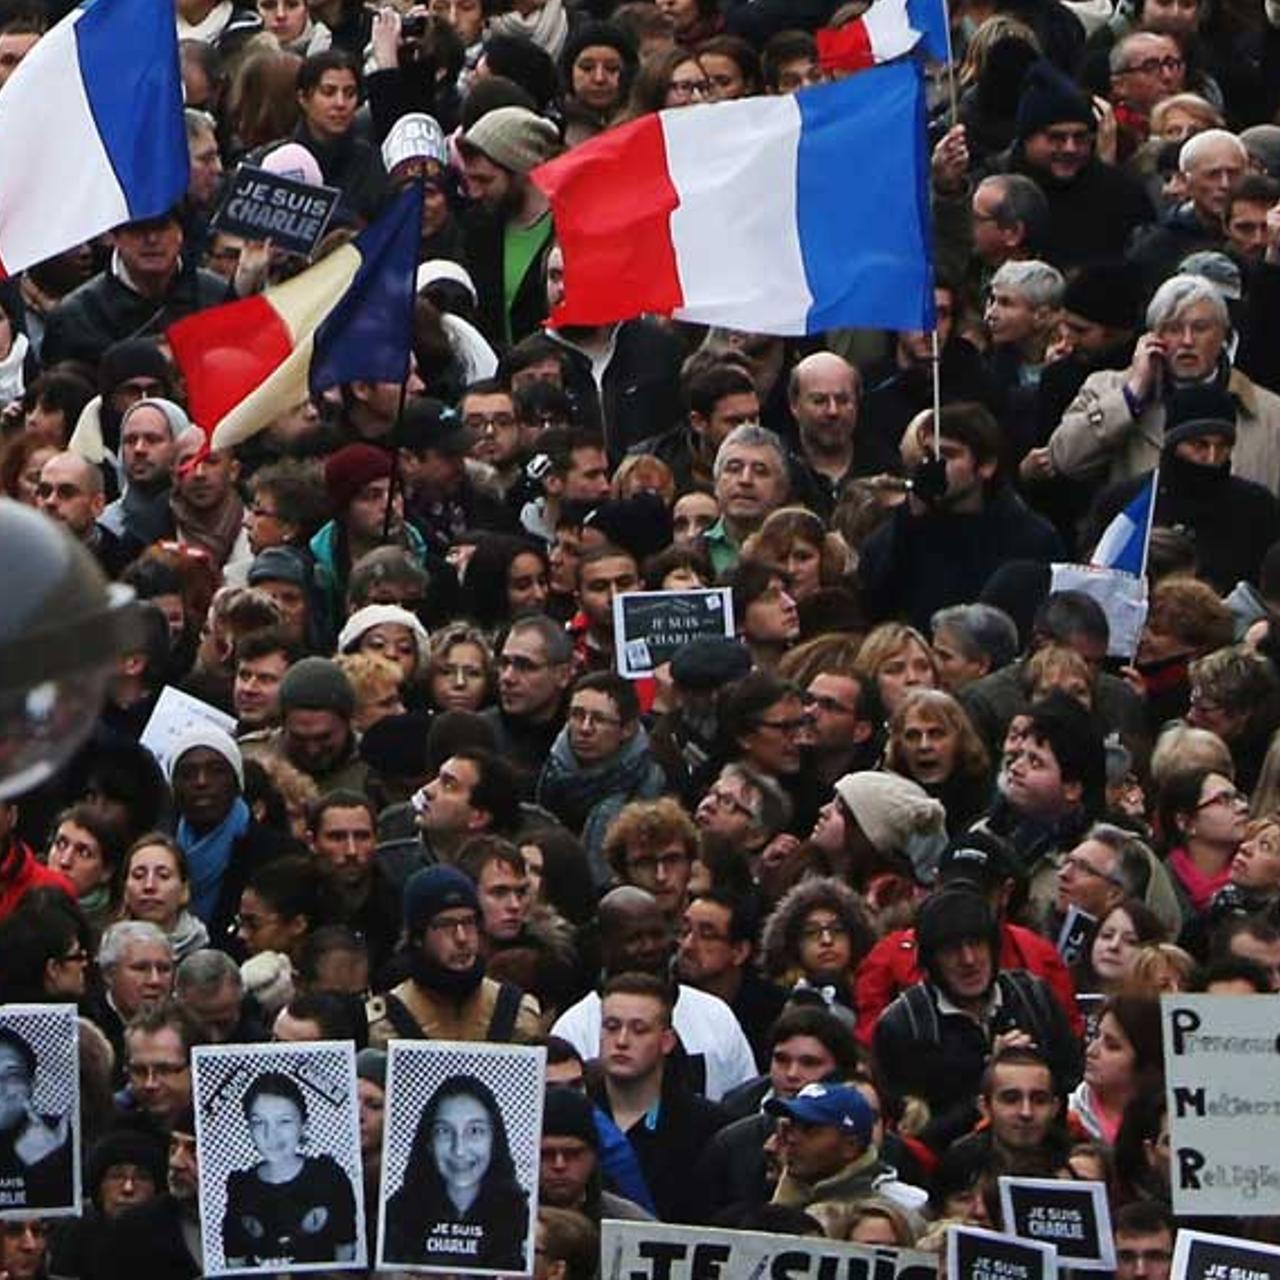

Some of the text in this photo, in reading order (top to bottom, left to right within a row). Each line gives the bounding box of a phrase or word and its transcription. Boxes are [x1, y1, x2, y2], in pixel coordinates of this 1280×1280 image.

[236, 181, 328, 218] JE SUIS
[227, 198, 323, 242] CHARLIE
[431, 1222, 483, 1237] JE SUIS
[427, 1237, 478, 1255] CHARLIE
